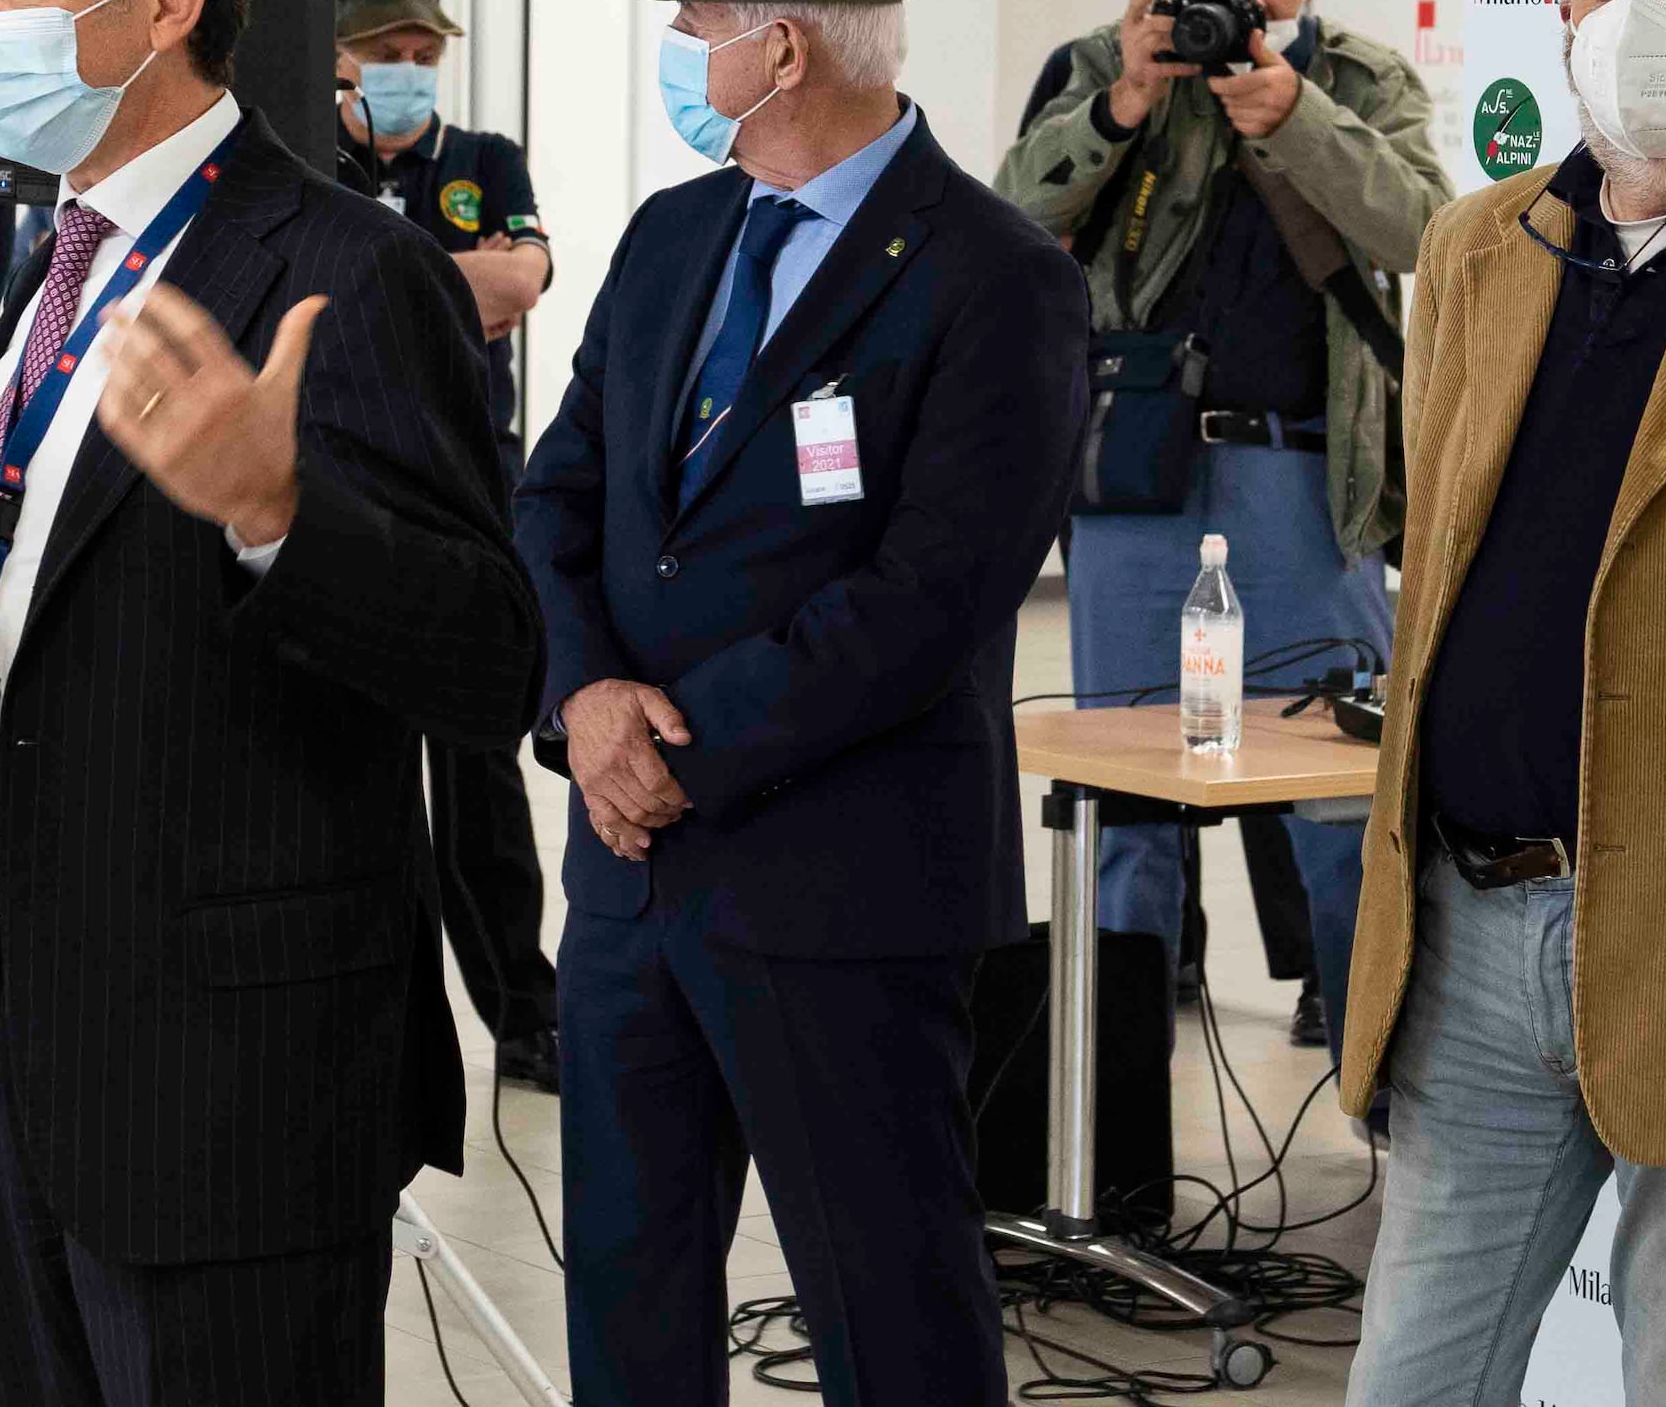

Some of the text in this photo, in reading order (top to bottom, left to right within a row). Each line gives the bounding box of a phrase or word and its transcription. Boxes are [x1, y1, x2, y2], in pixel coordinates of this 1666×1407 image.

[1497, 152, 1532, 166] ALPINI
[806, 444, 844, 458] Visitor
[812, 458, 842, 472] 2021
